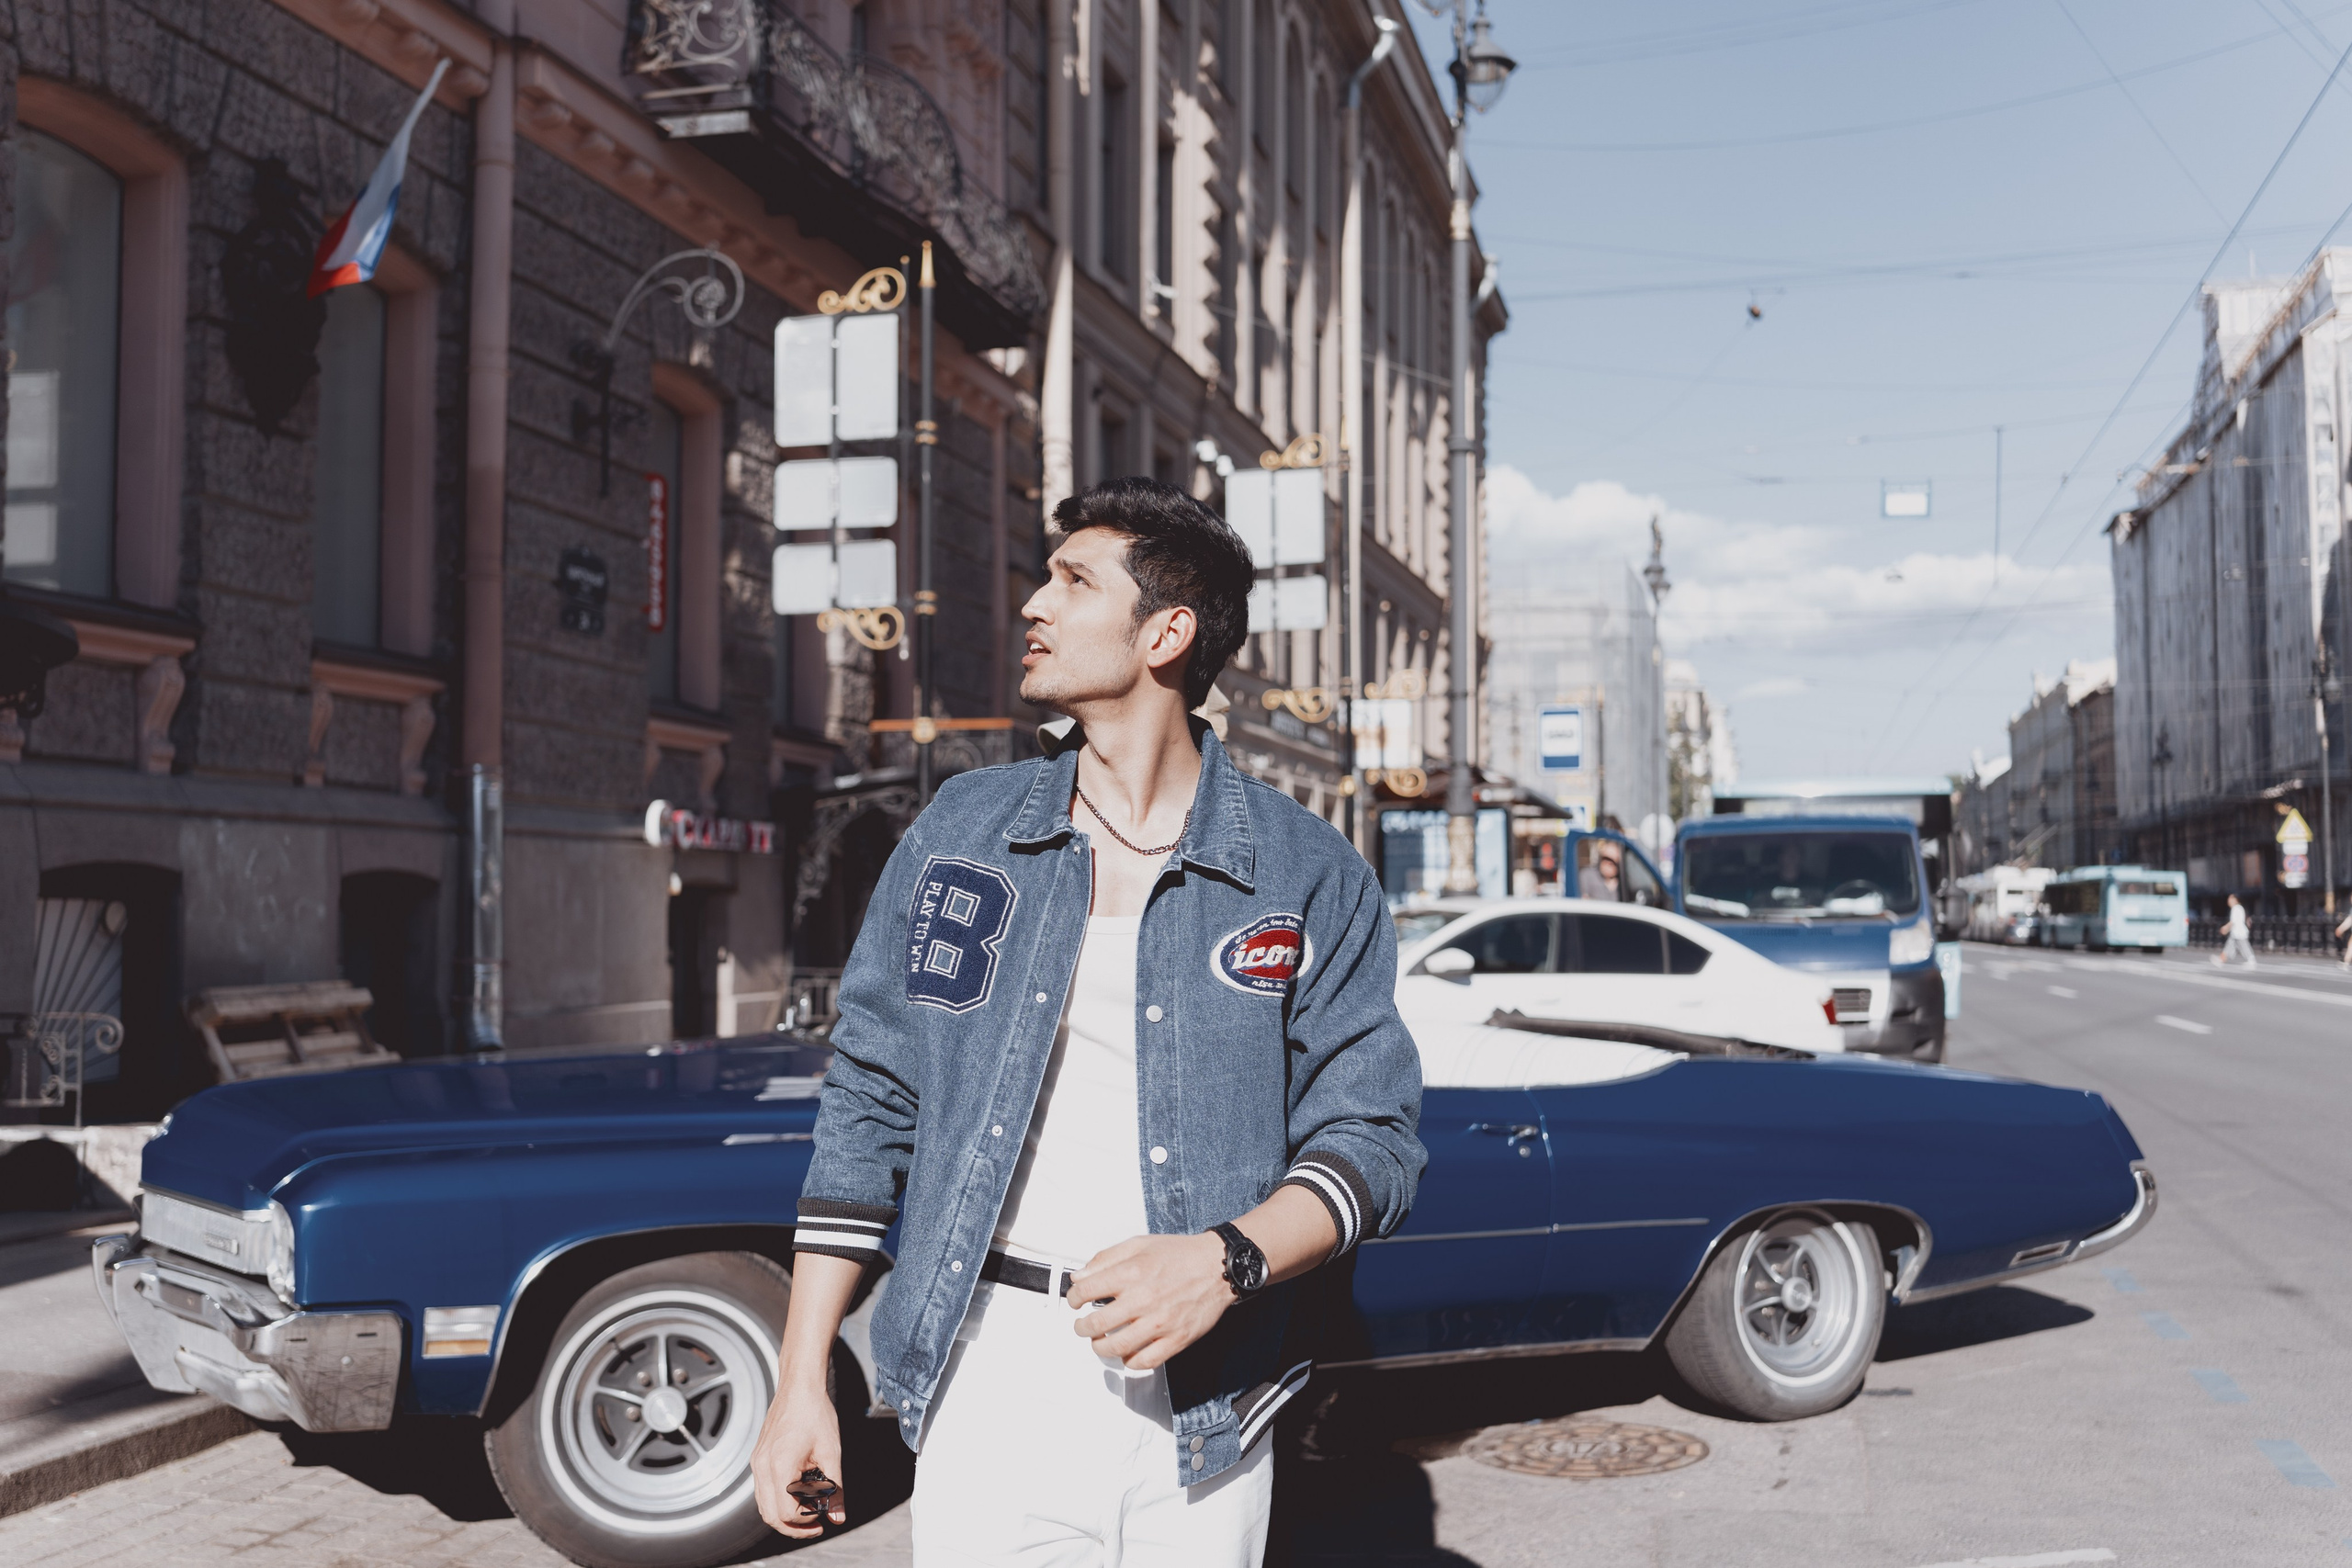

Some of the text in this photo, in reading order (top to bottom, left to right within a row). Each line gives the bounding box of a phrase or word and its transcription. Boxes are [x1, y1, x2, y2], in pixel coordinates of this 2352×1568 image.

[920, 881, 944, 917] PLAY
[914, 921, 930, 940] TO
[1231, 943, 1300, 970] icon
